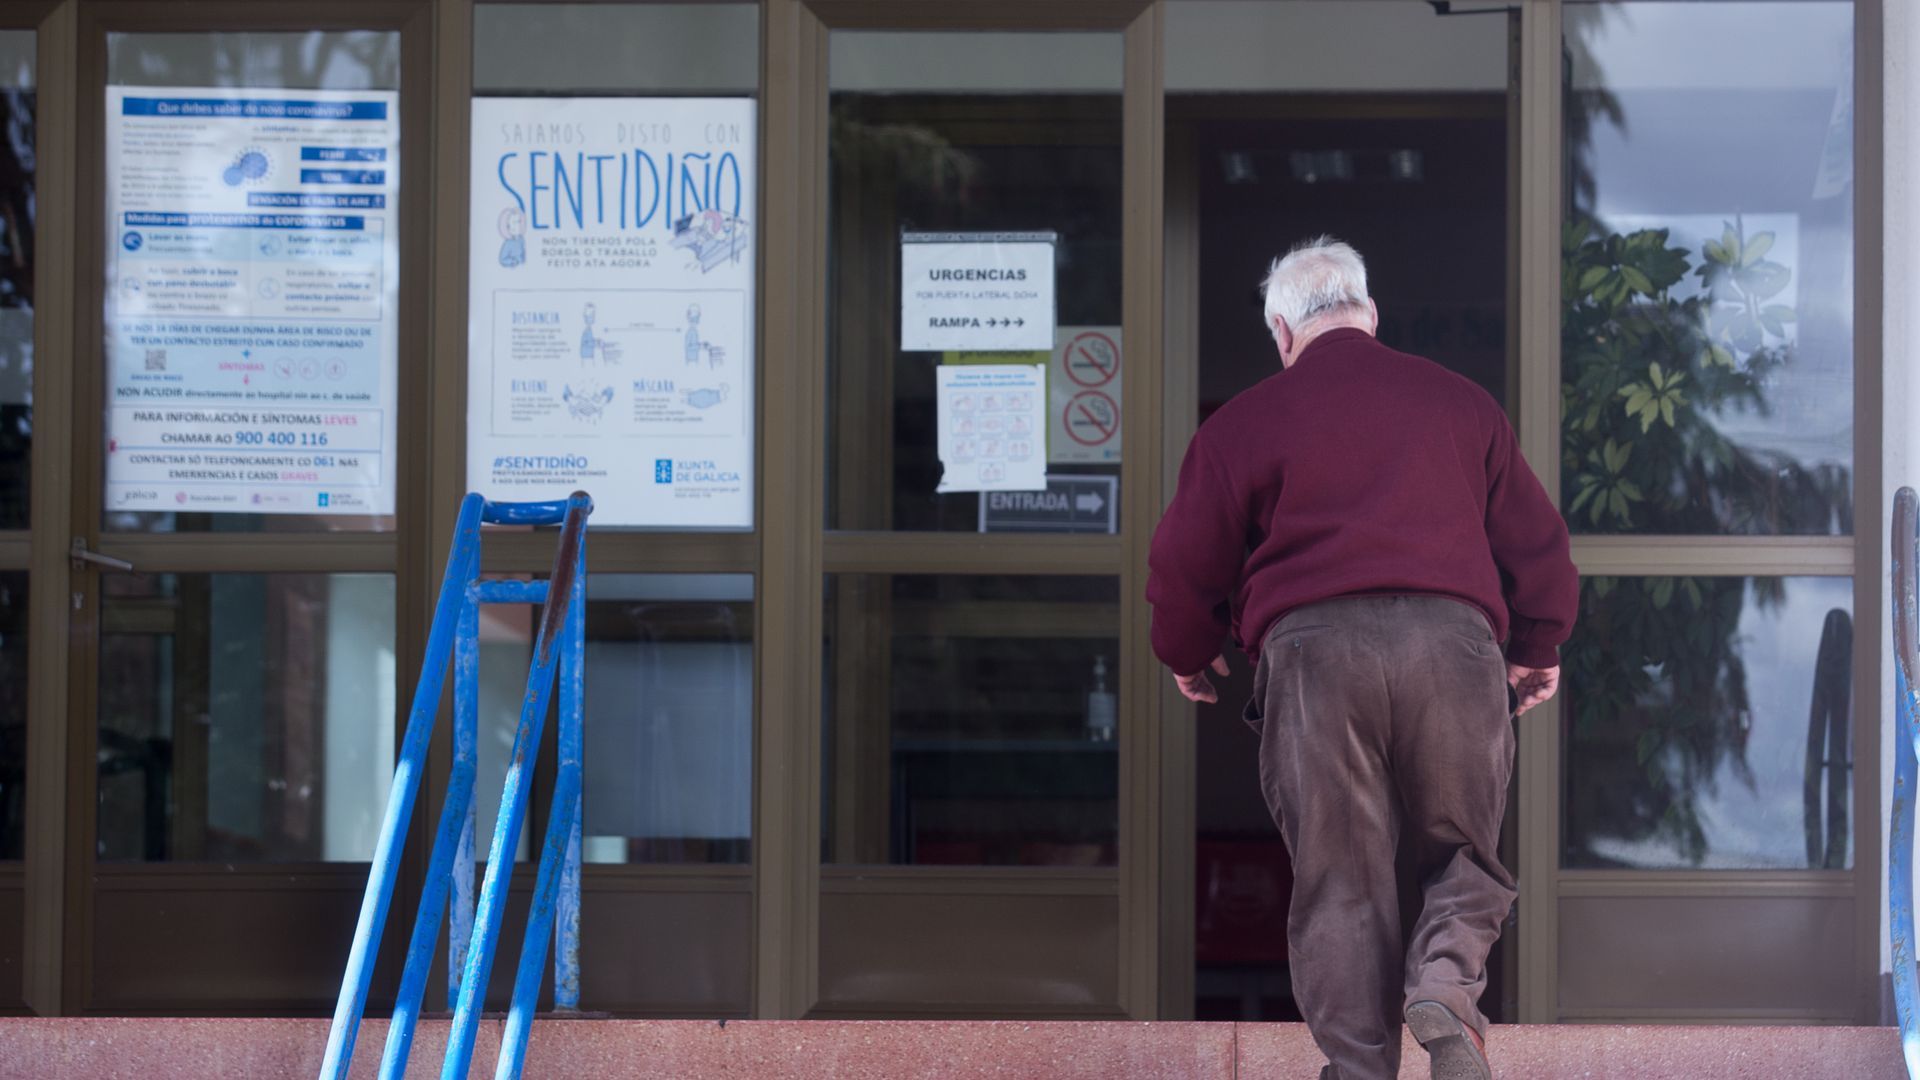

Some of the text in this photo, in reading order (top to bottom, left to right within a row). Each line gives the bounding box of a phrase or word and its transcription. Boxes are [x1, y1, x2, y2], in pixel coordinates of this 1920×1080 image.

[704, 123, 740, 144] CON
[498, 148, 741, 230] SENTIDIÑO
[929, 269, 1027, 281] URGENCIAS
[929, 317, 981, 328] RAMPA
[117, 387, 140, 397] NON
[133, 412, 163, 423] PARA
[165, 411, 249, 424] INFORMACIÓN
[262, 412, 322, 425] SÍNTOMAS
[161, 431, 328, 446] CHAMAR AO 900 400 116
[130, 454, 185, 465] CONTACTAR
[313, 456, 335, 467] 061
[493, 453, 588, 469] #SENTIDIÑO
[677, 460, 716, 470] XUNTA
[693, 472, 741, 482] GALICIA
[990, 493, 1069, 510] ENTRADA
